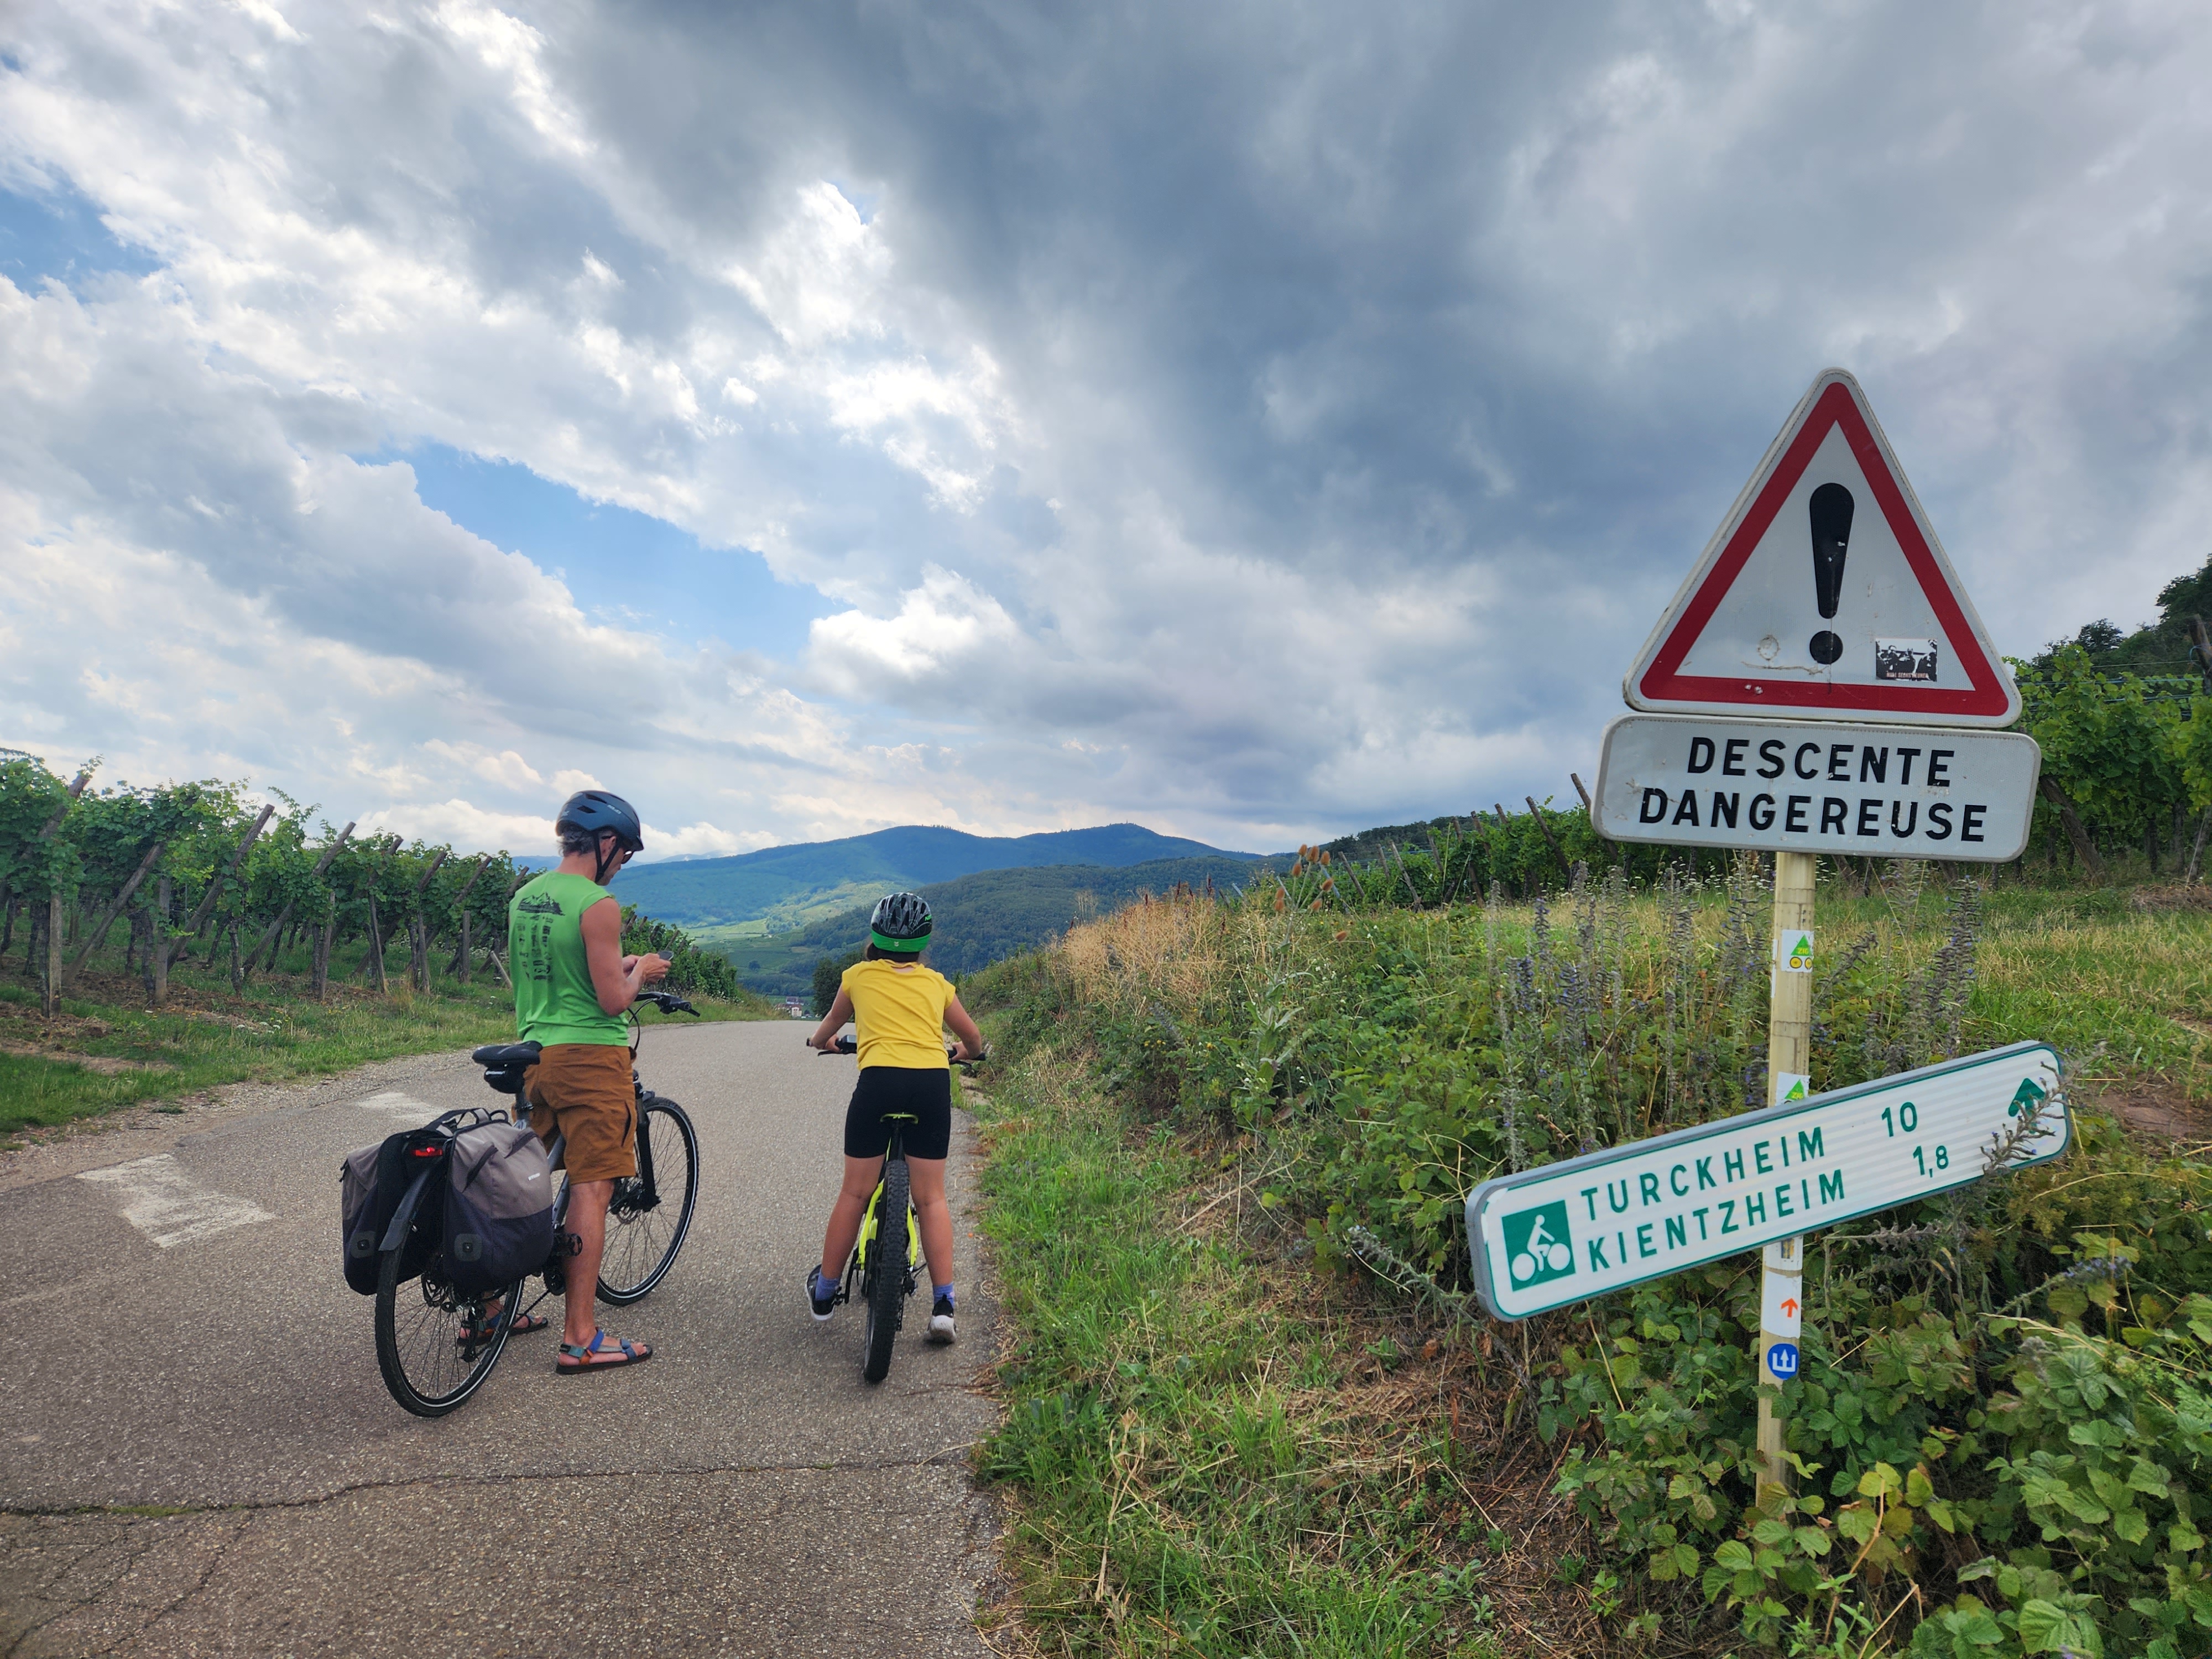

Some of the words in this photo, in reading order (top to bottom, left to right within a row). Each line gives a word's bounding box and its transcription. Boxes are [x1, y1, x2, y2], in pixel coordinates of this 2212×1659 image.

[1688, 737, 1954, 787] DESCENTE
[1639, 787, 1987, 842] DANGEREUSE
[1580, 1126, 1825, 1222] TURCKHEIM
[1881, 1101, 1918, 1138] 10
[1587, 1169, 1845, 1273] KIENTZHEIM
[1912, 1145, 1949, 1178] 1,8
